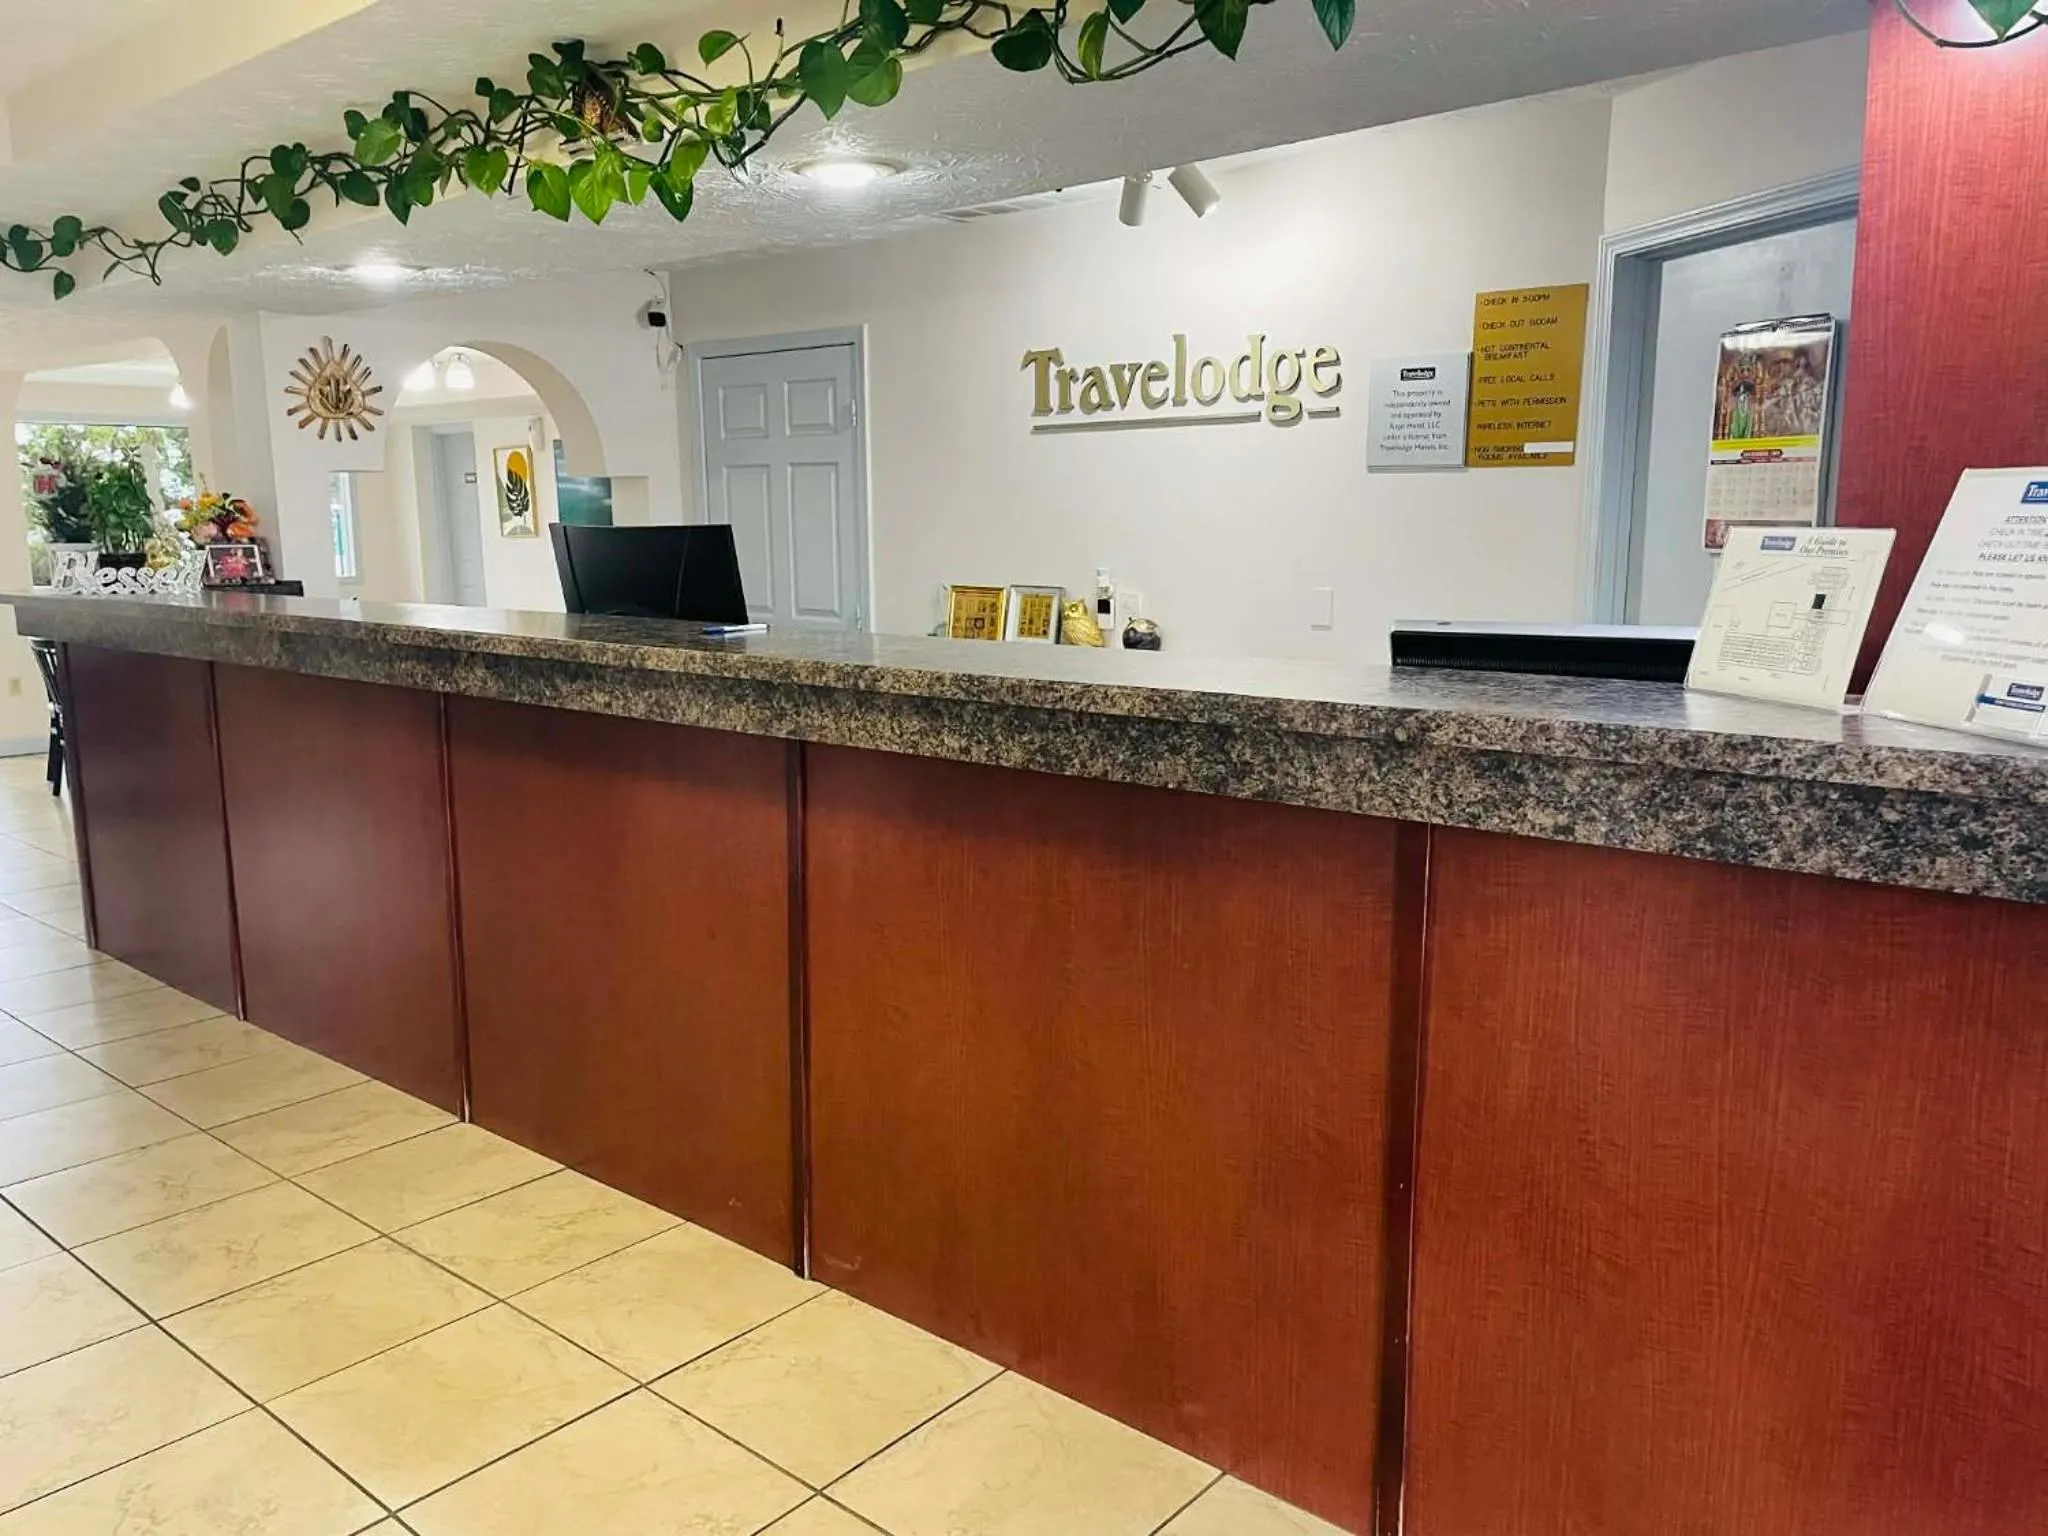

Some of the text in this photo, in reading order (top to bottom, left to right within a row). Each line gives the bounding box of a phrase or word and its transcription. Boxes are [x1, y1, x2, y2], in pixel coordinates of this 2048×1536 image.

[1482, 297, 1507, 307] CHECK
[1511, 295, 1519, 304] IN
[1482, 321, 1507, 330] CHECK
[1509, 319, 1526, 329] OUT
[1020, 333, 1342, 427] Travelodge
[1478, 373, 1555, 385] FREE LOCAL CALLS
[1500, 399, 1520, 408] WITH
[1522, 396, 1567, 407] PERMISSION
[53, 550, 207, 597] Blessed
